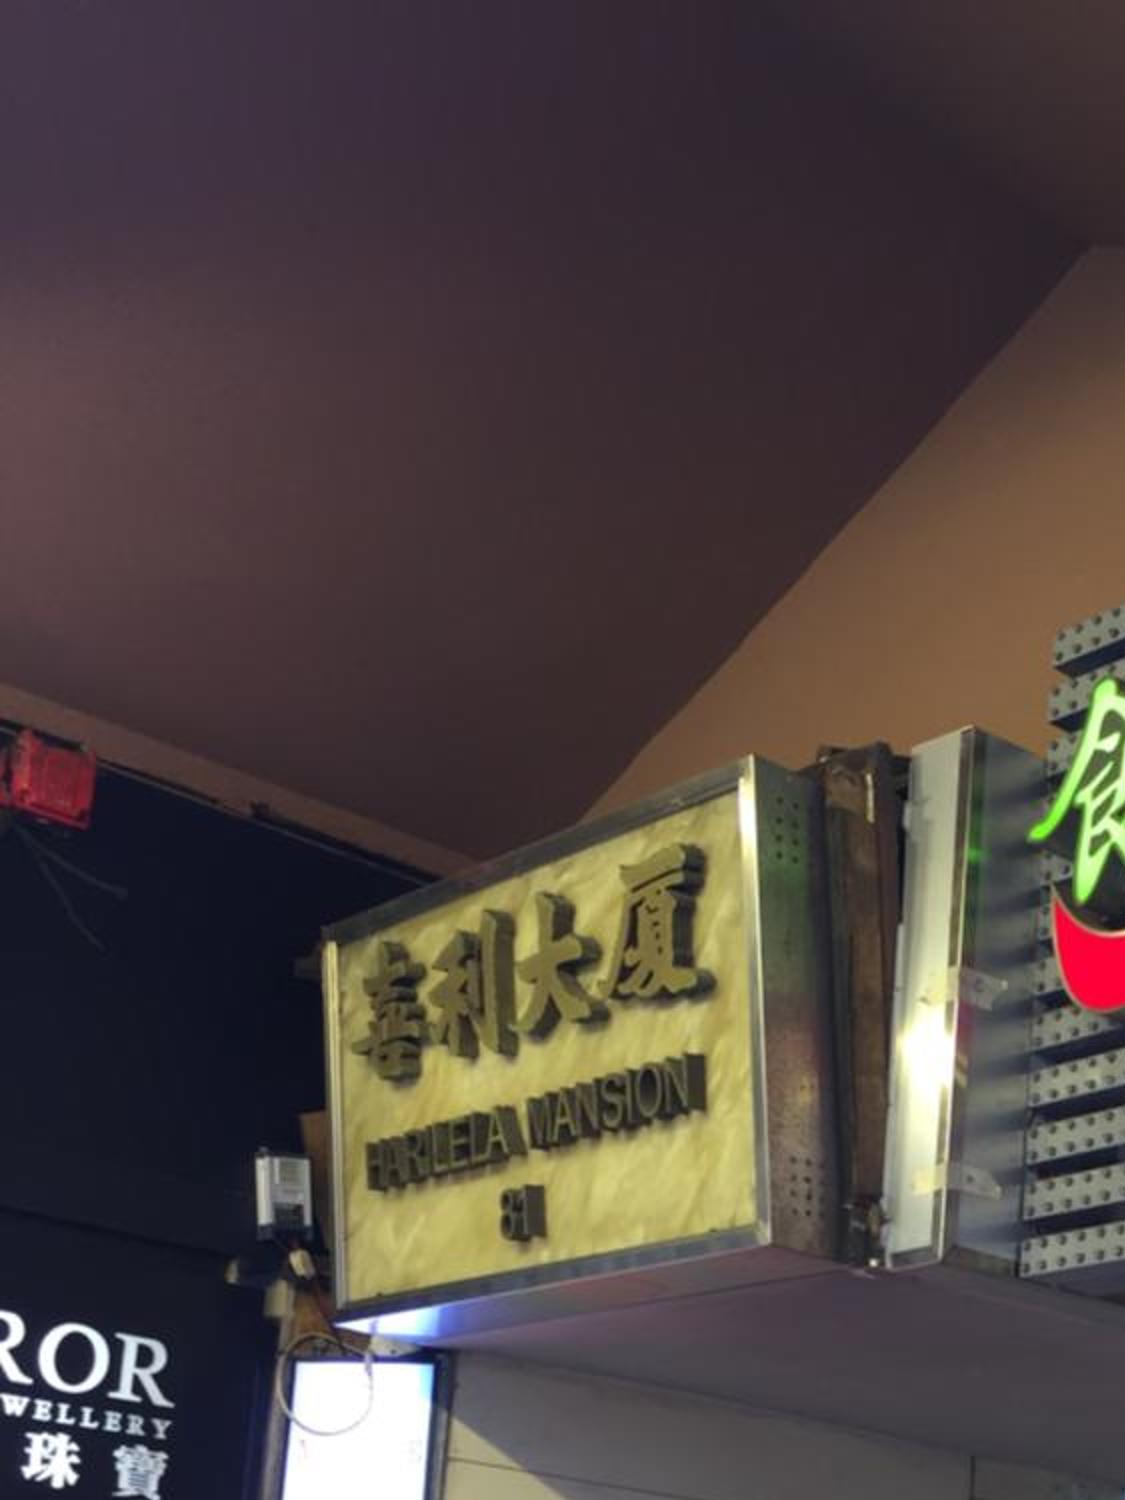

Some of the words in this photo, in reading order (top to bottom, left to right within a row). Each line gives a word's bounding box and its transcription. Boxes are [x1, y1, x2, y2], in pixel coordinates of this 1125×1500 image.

[366, 1104, 527, 1192] HARILELA
[527, 1053, 708, 1151] MANSION
[0, 1309, 176, 1409] ROR
